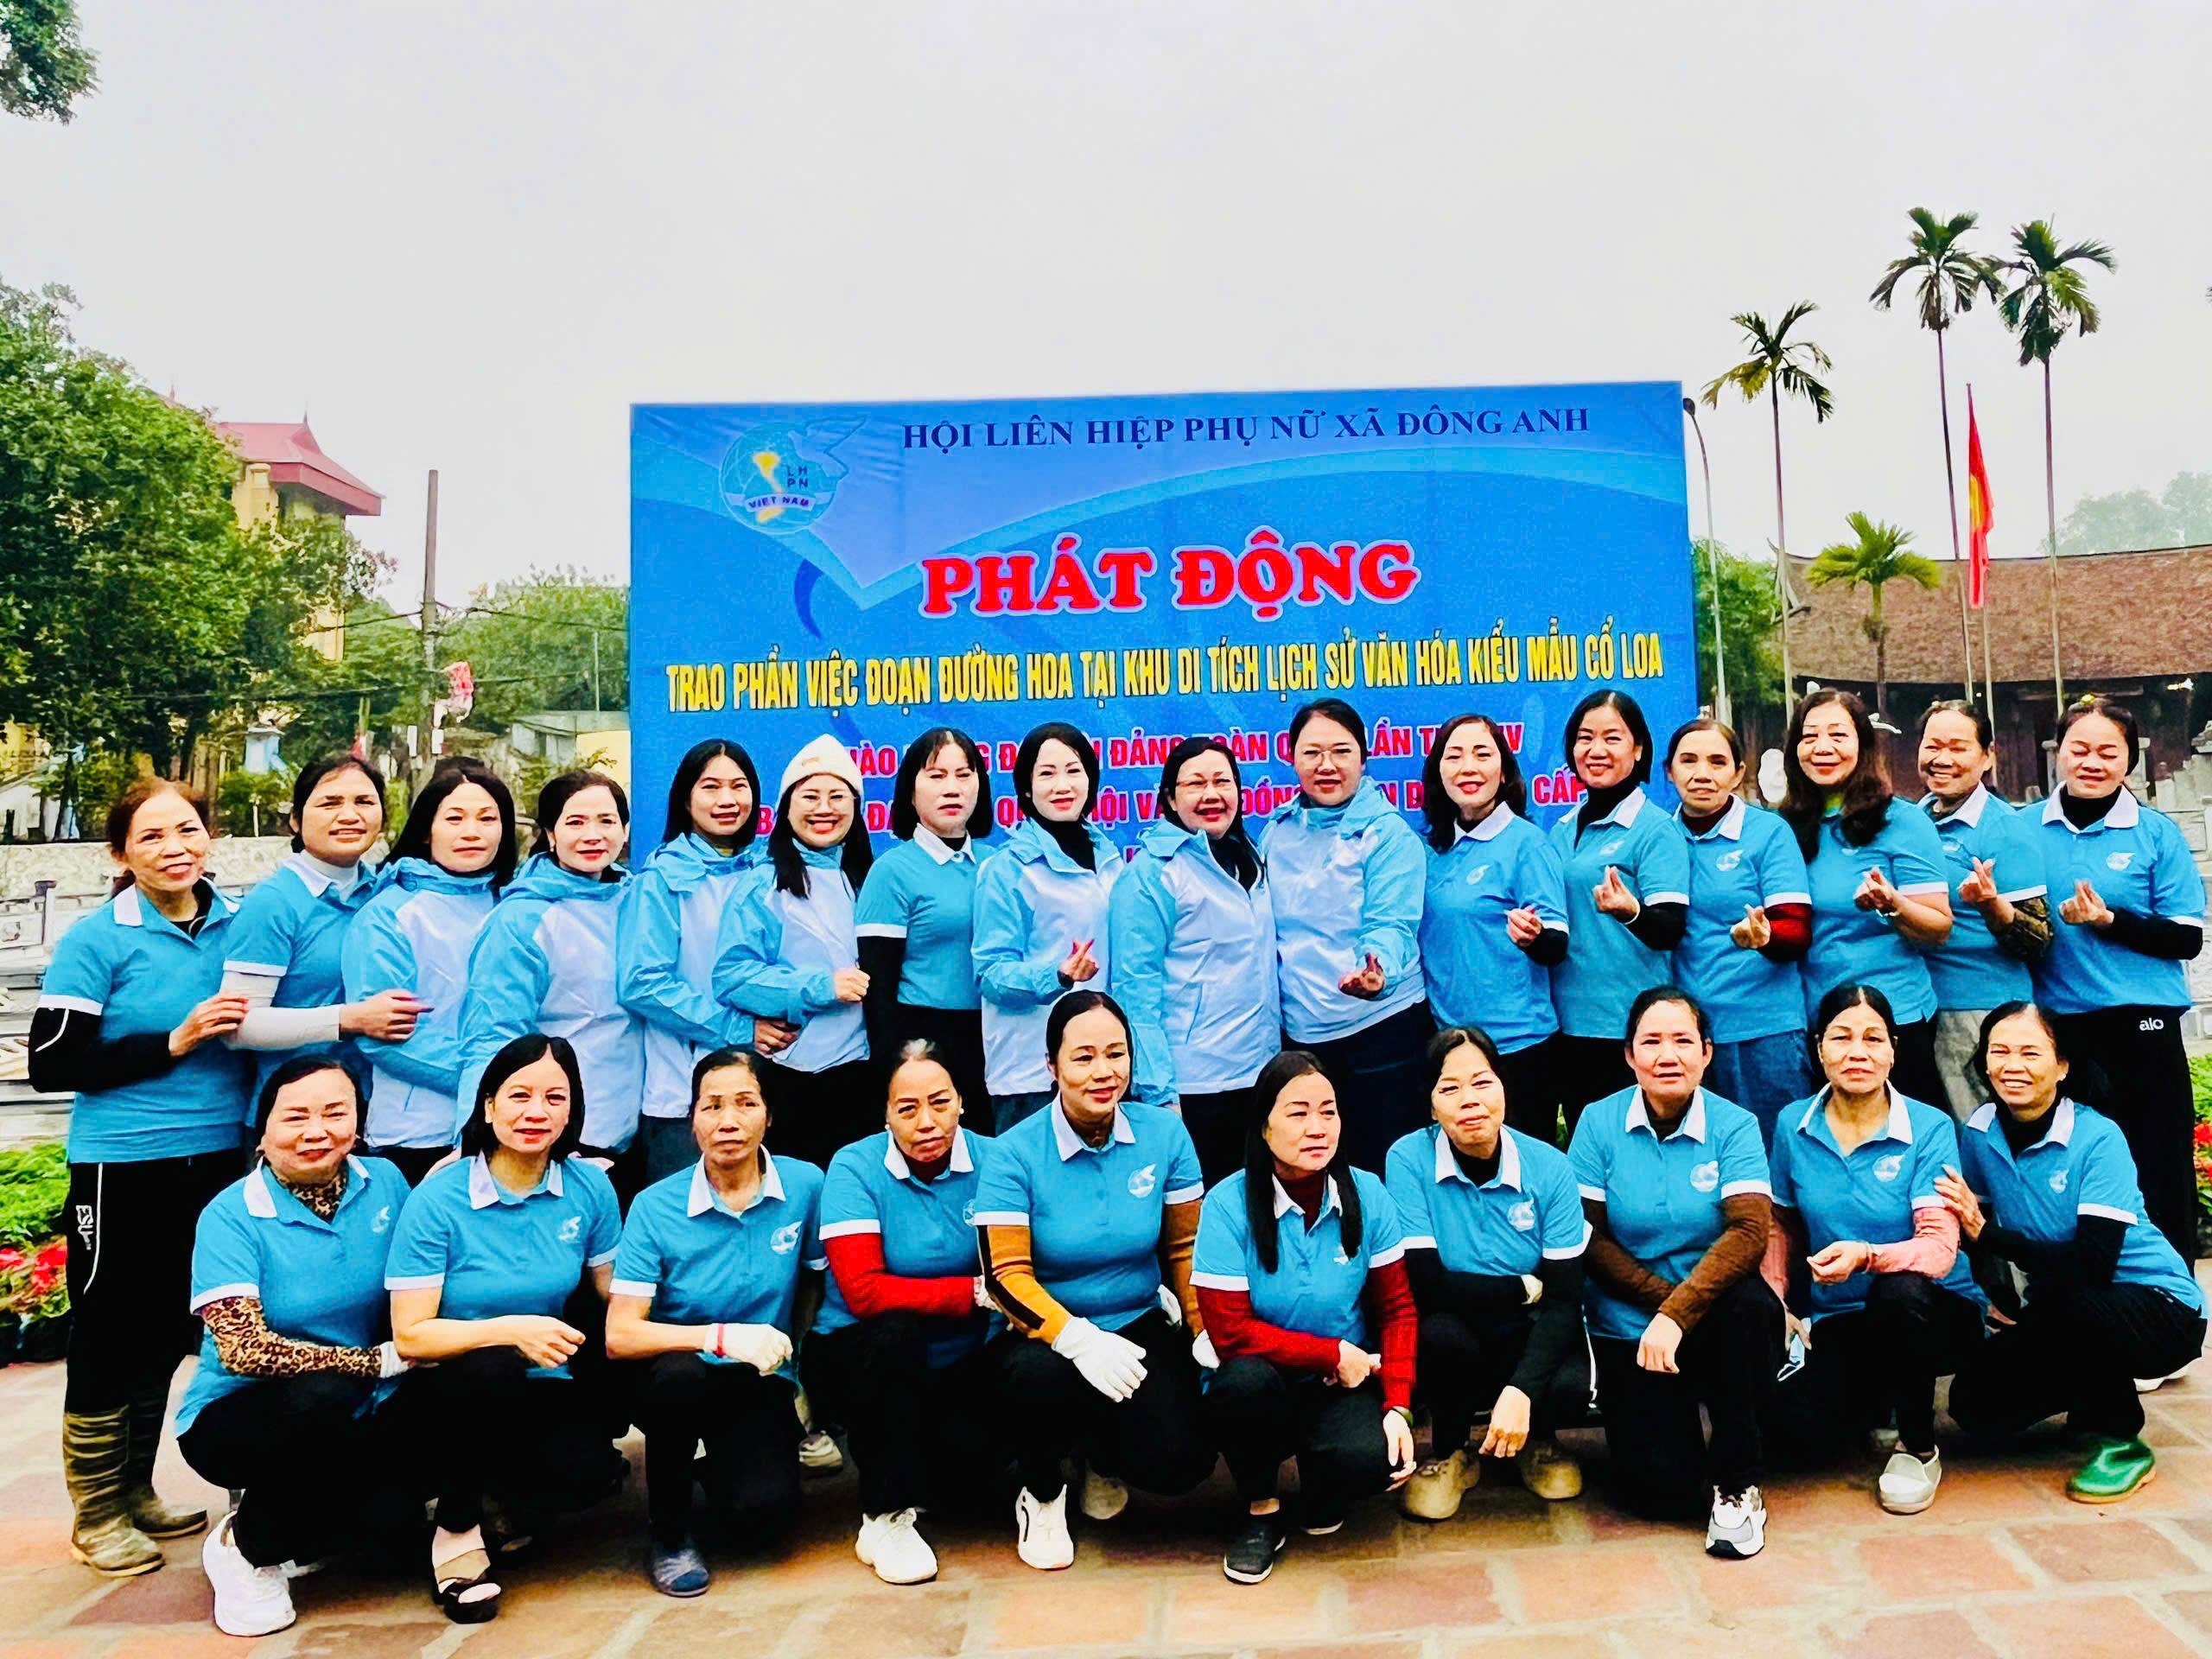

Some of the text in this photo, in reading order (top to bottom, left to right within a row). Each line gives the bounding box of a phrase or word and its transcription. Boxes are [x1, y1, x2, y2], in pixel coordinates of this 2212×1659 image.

[903, 404, 1588, 454] HỘI LIÊN HIỆP PHỤ NỮ XÃ ĐÔNG ANH
[920, 528, 1420, 620] PHÁT ĐỘNG
[665, 614, 1664, 718] TRAO PHẦN VIỆC ĐOẠN ĐƯỜNG HOA TẠI KHU DI TÍCH LỊCH SỬ VĂN HÓA KIỂU MẪU CỔ LOA
[2139, 1017, 2164, 1031] alo
